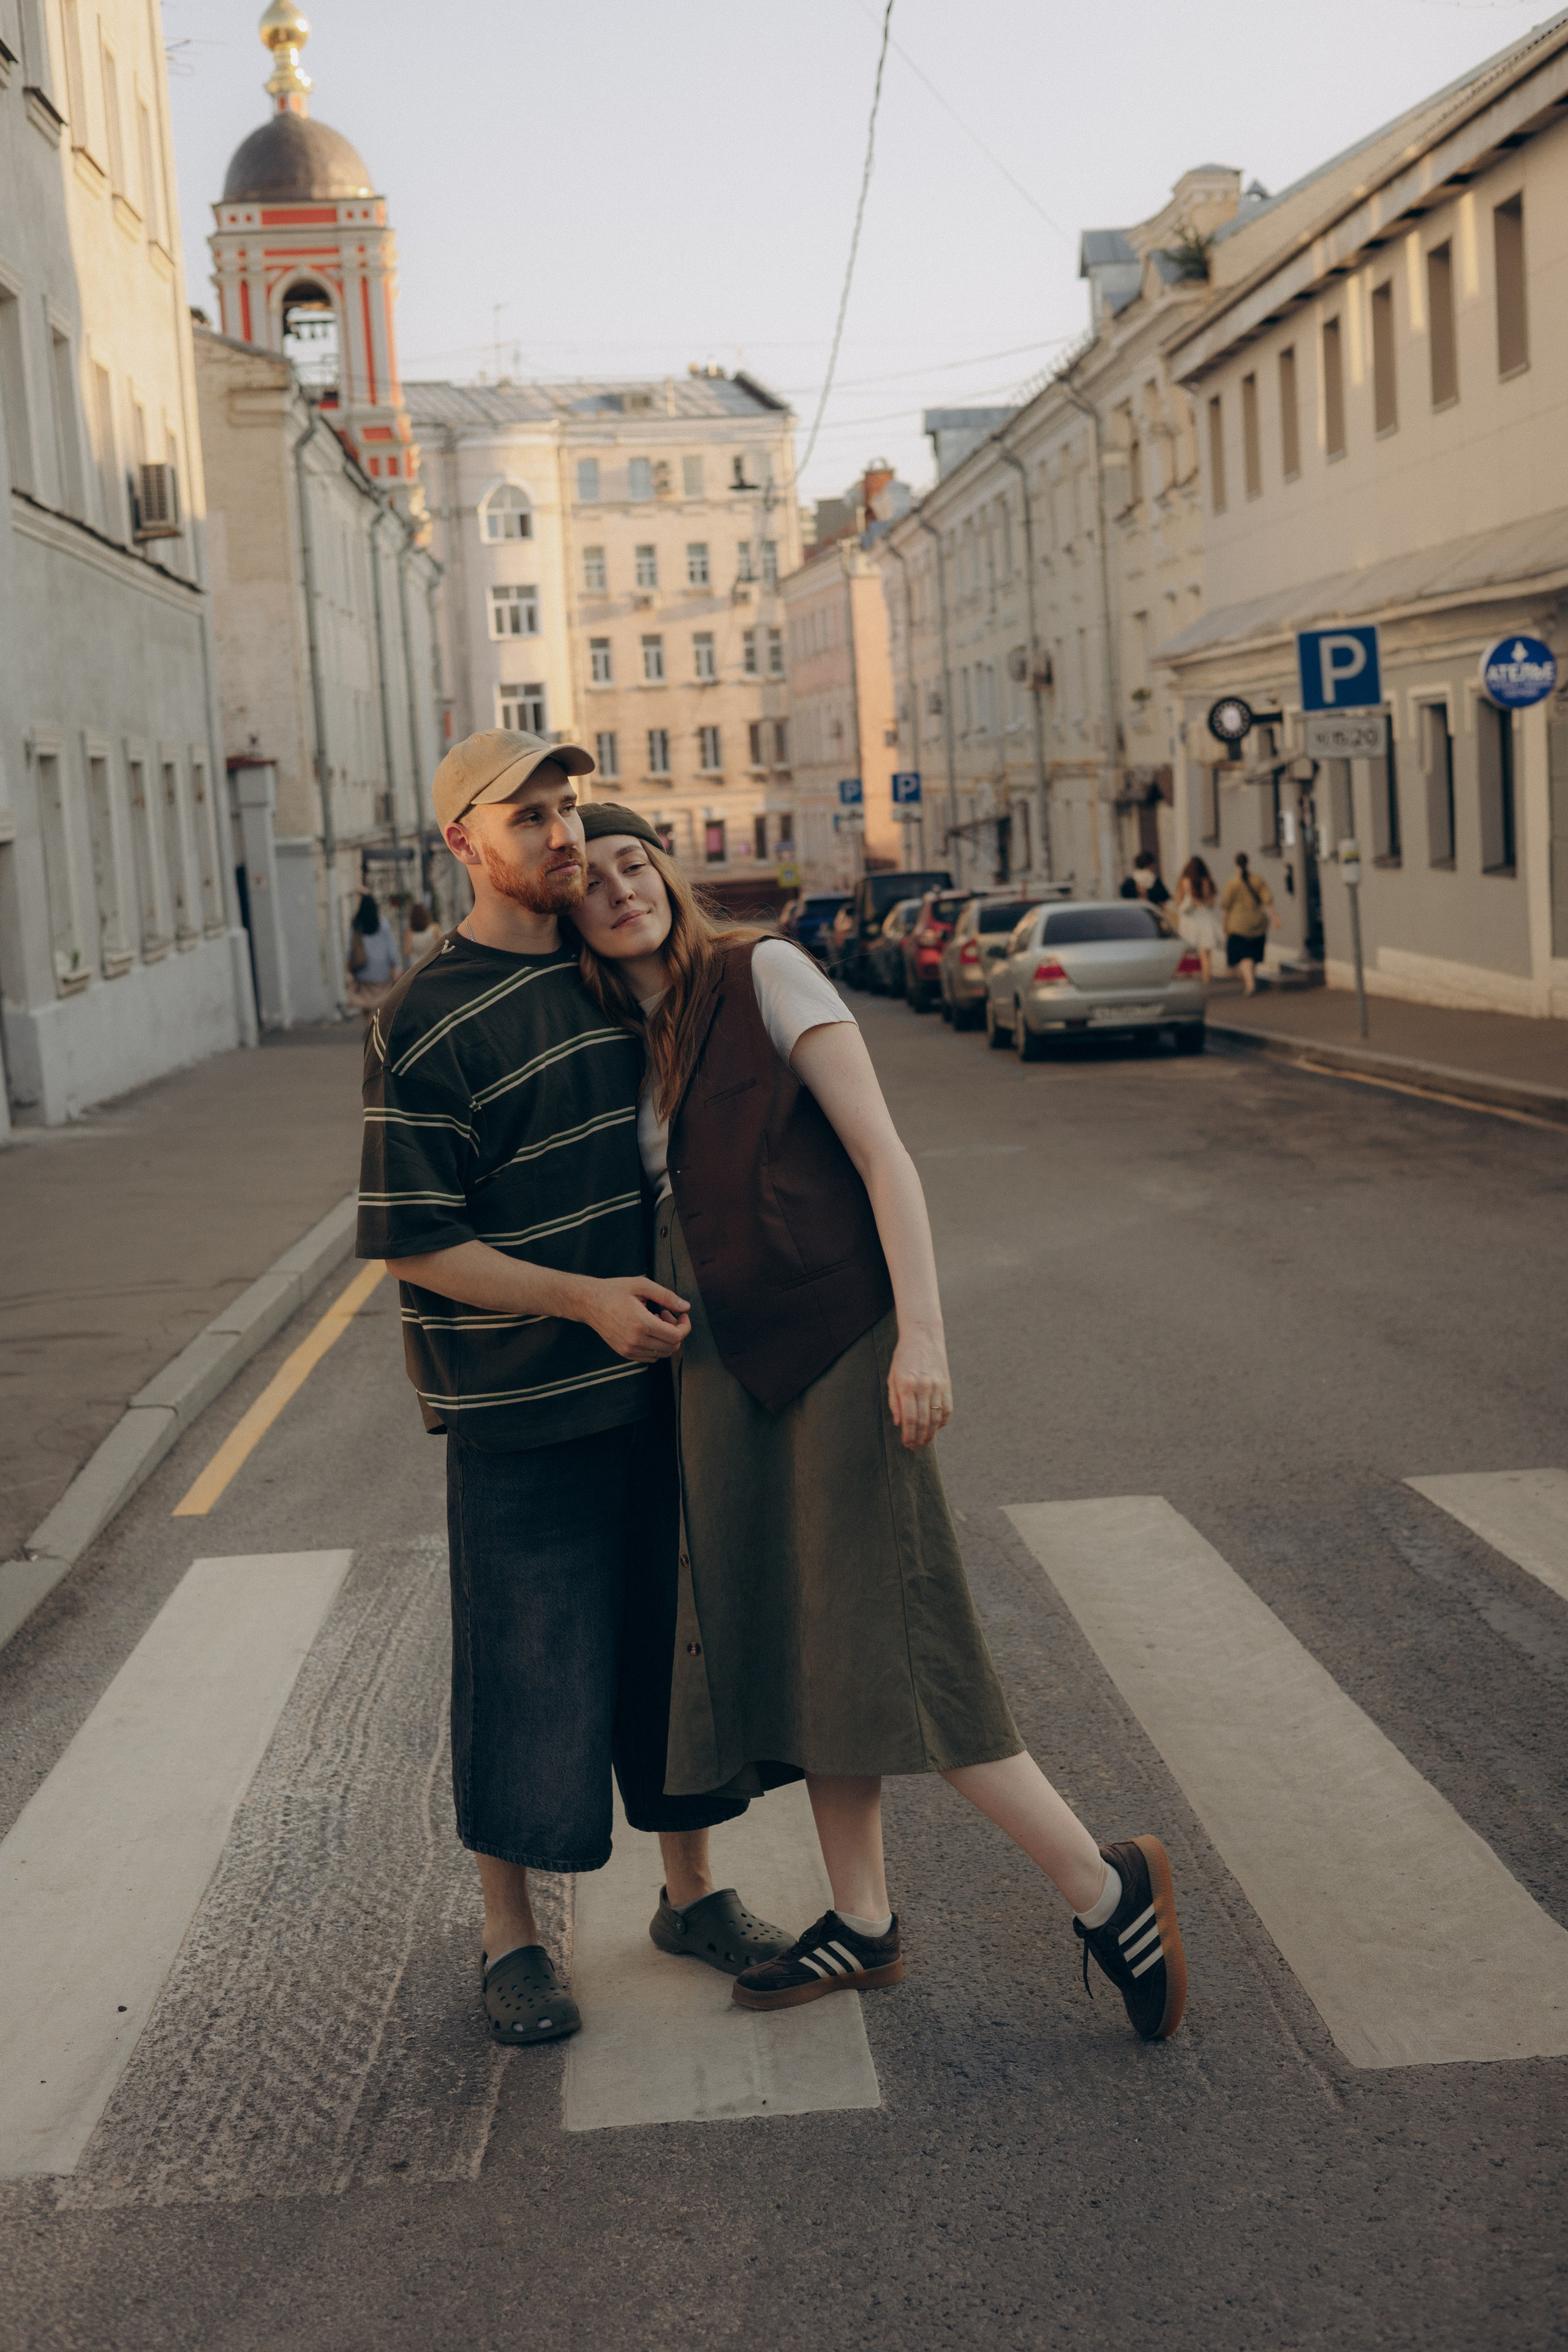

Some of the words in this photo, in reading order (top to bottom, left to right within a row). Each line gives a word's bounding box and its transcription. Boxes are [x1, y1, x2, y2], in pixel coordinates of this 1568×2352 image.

[1319, 635, 1366, 704] P
[1487, 662, 1555, 681] АТЕЛЬЕ
[844, 782, 860, 804] P
[897, 775, 918, 802] P
